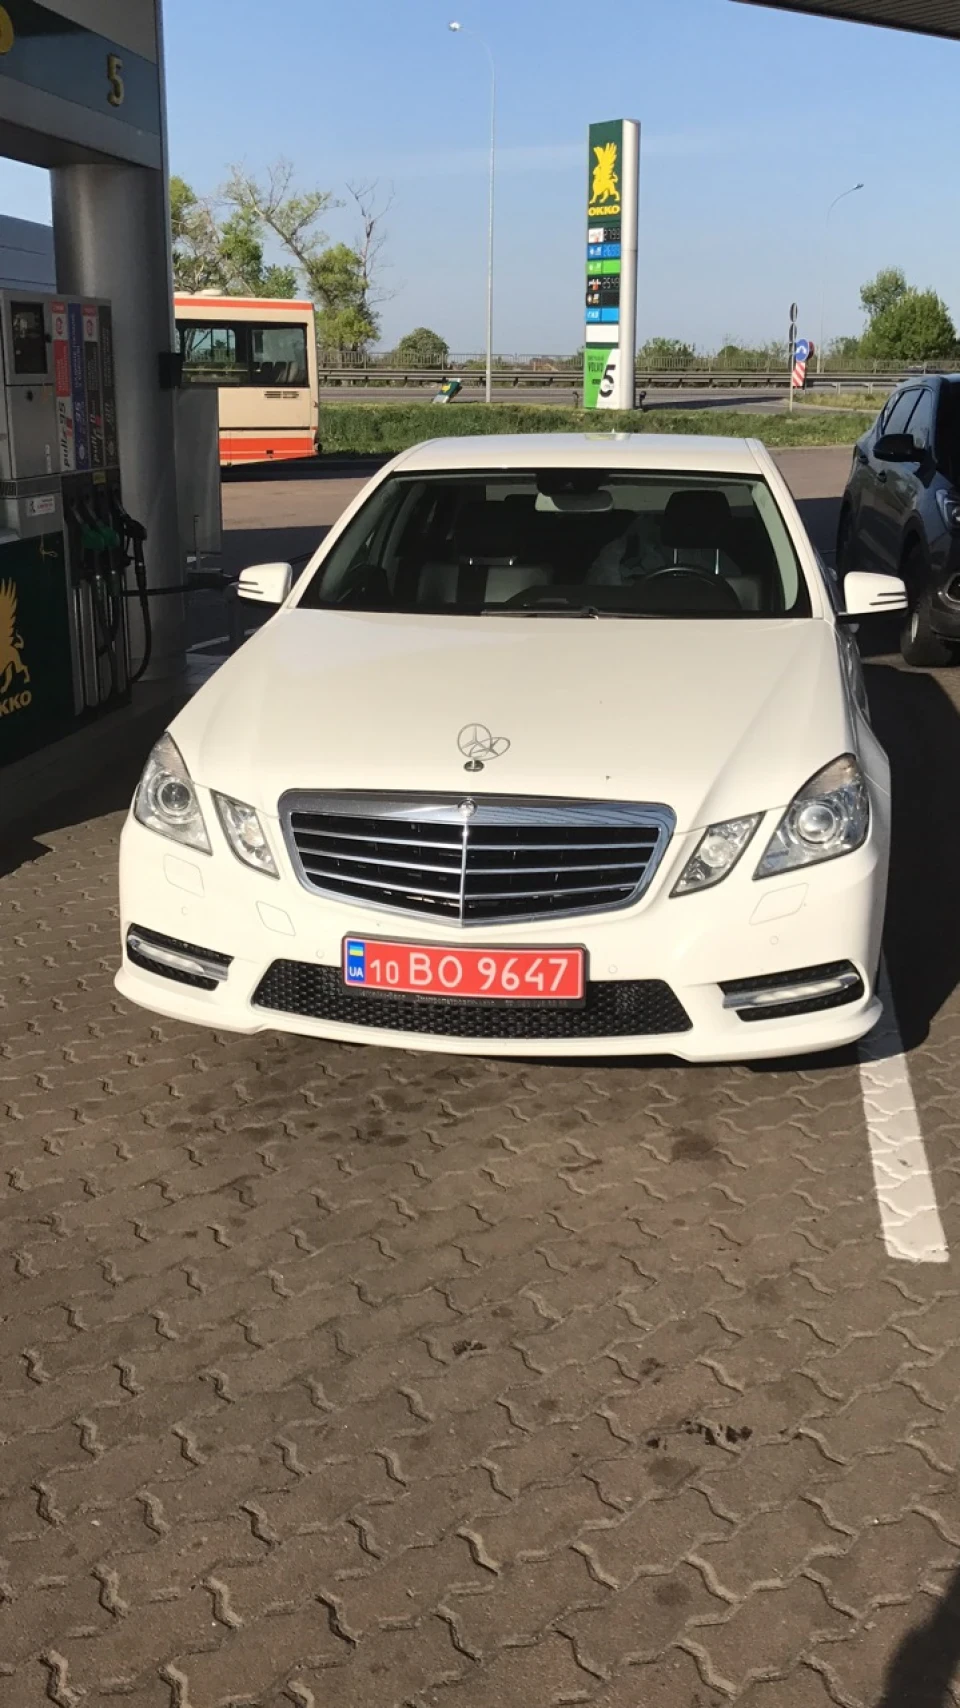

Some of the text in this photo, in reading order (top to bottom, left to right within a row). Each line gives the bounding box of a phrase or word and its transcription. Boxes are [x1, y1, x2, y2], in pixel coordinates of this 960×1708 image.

[107, 53, 124, 107] 5
[588, 205, 620, 216] OKKO
[599, 364, 616, 398] 5
[349, 966, 364, 978] UA
[370, 952, 568, 991] 10 BO 9647
